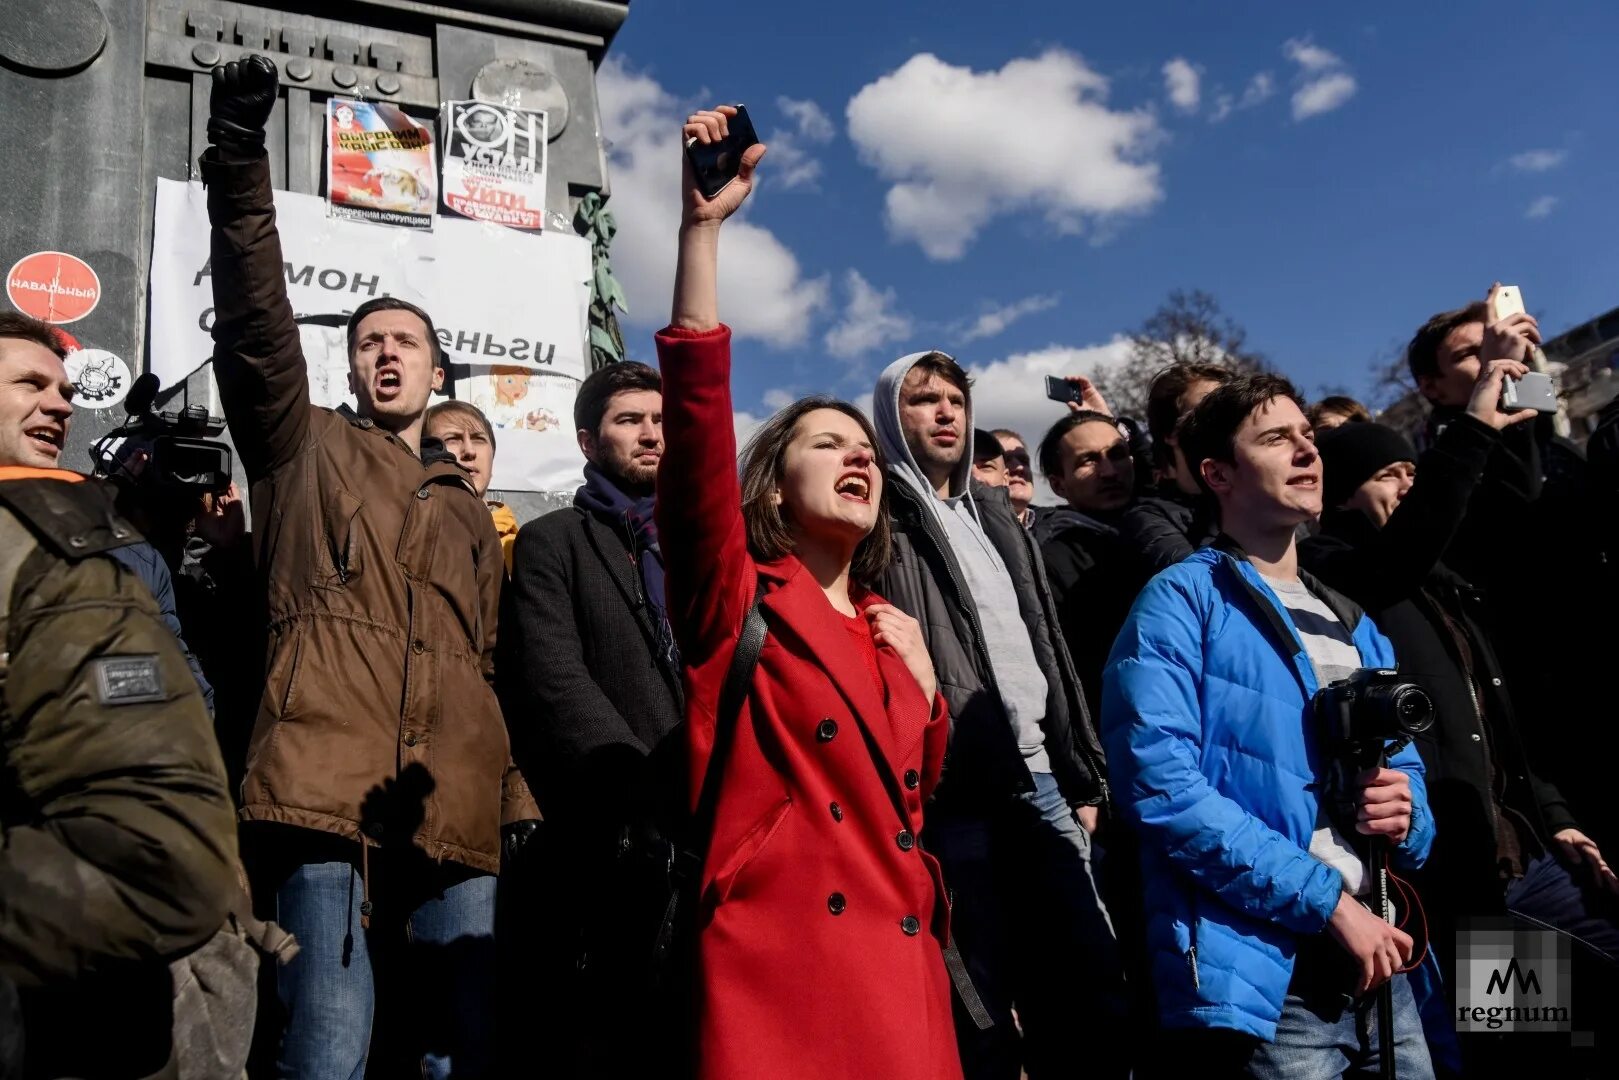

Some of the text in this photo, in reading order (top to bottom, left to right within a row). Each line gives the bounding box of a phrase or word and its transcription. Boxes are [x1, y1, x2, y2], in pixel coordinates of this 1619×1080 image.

[456, 103, 536, 158] ОН
[460, 142, 535, 173] УСТАЛ
[11, 278, 96, 299] НАВАЛЬНЫЙ
